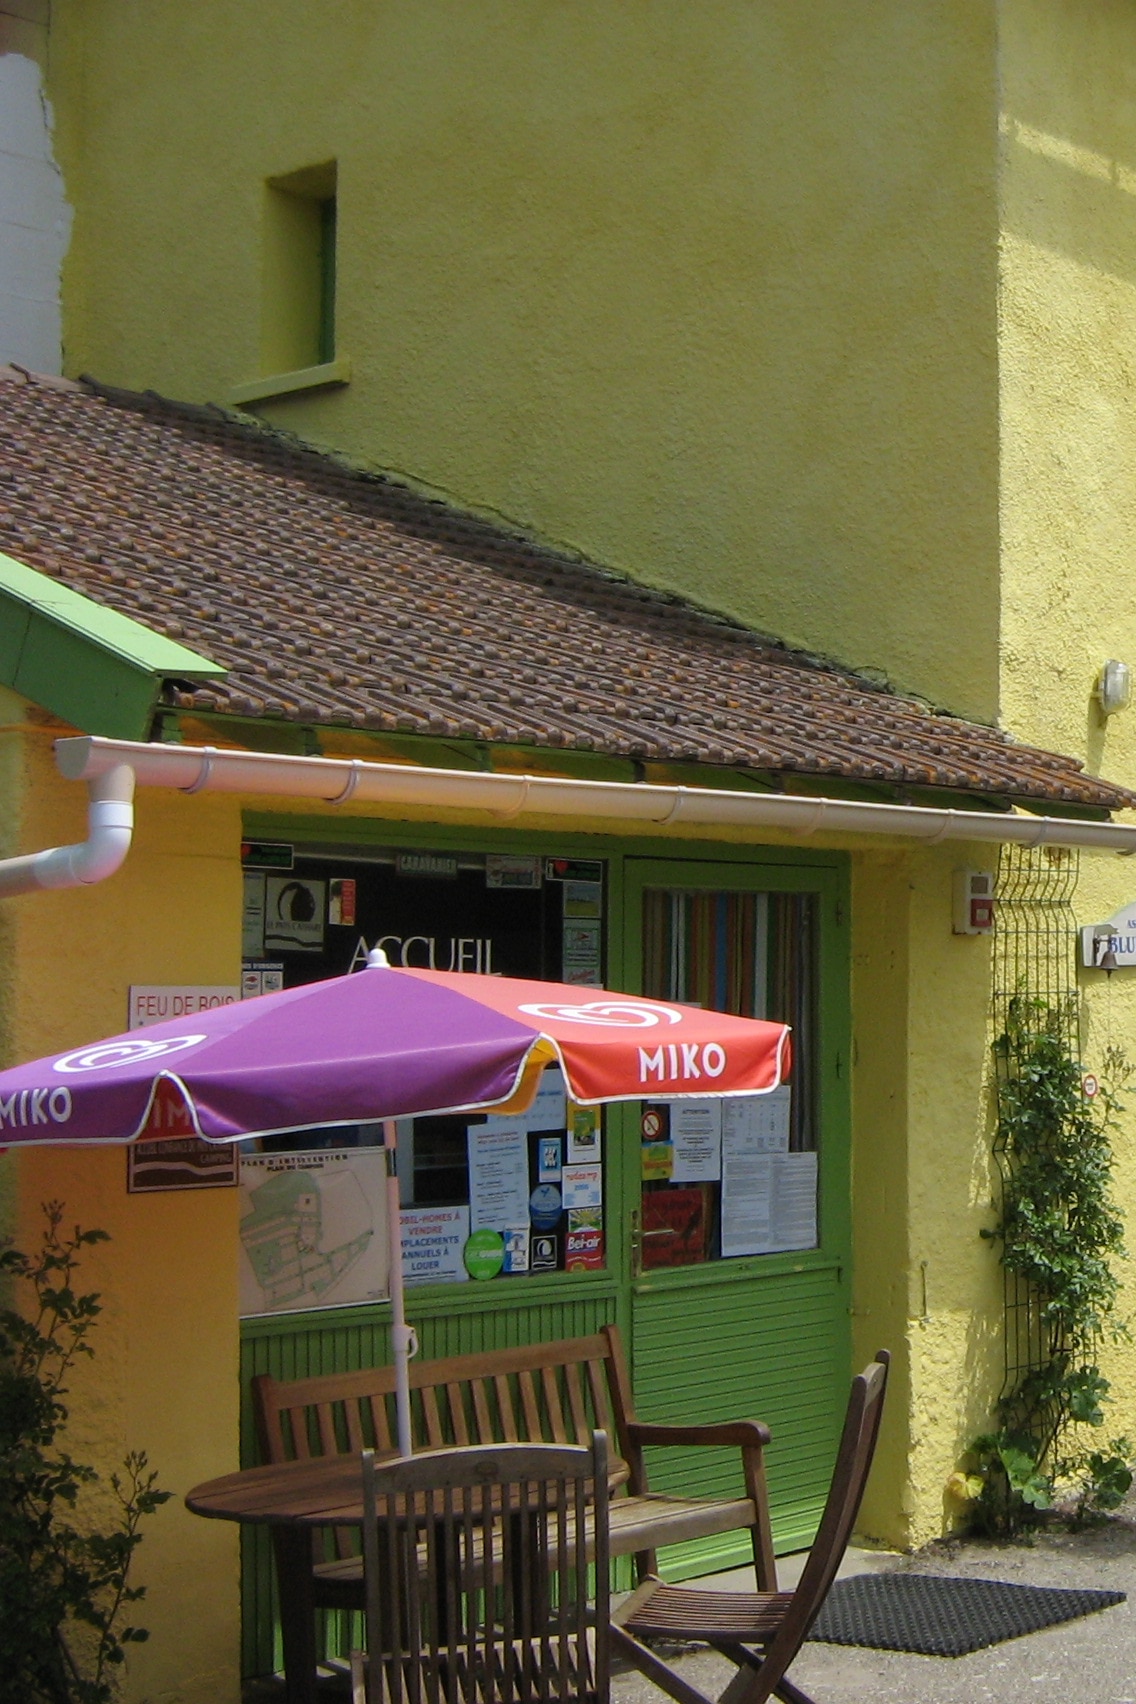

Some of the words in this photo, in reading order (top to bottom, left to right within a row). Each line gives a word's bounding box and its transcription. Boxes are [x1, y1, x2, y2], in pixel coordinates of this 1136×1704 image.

[137, 996, 168, 1016] FEU
[173, 996, 194, 1015] DE
[638, 1042, 726, 1083] MIKO
[0, 1086, 72, 1130] MIKO
[408, 1225, 443, 1235] VENDRE
[401, 1235, 460, 1248] PLACEMENTS
[402, 1249, 441, 1259] ANNUELS
[411, 1260, 440, 1271] LOUER
